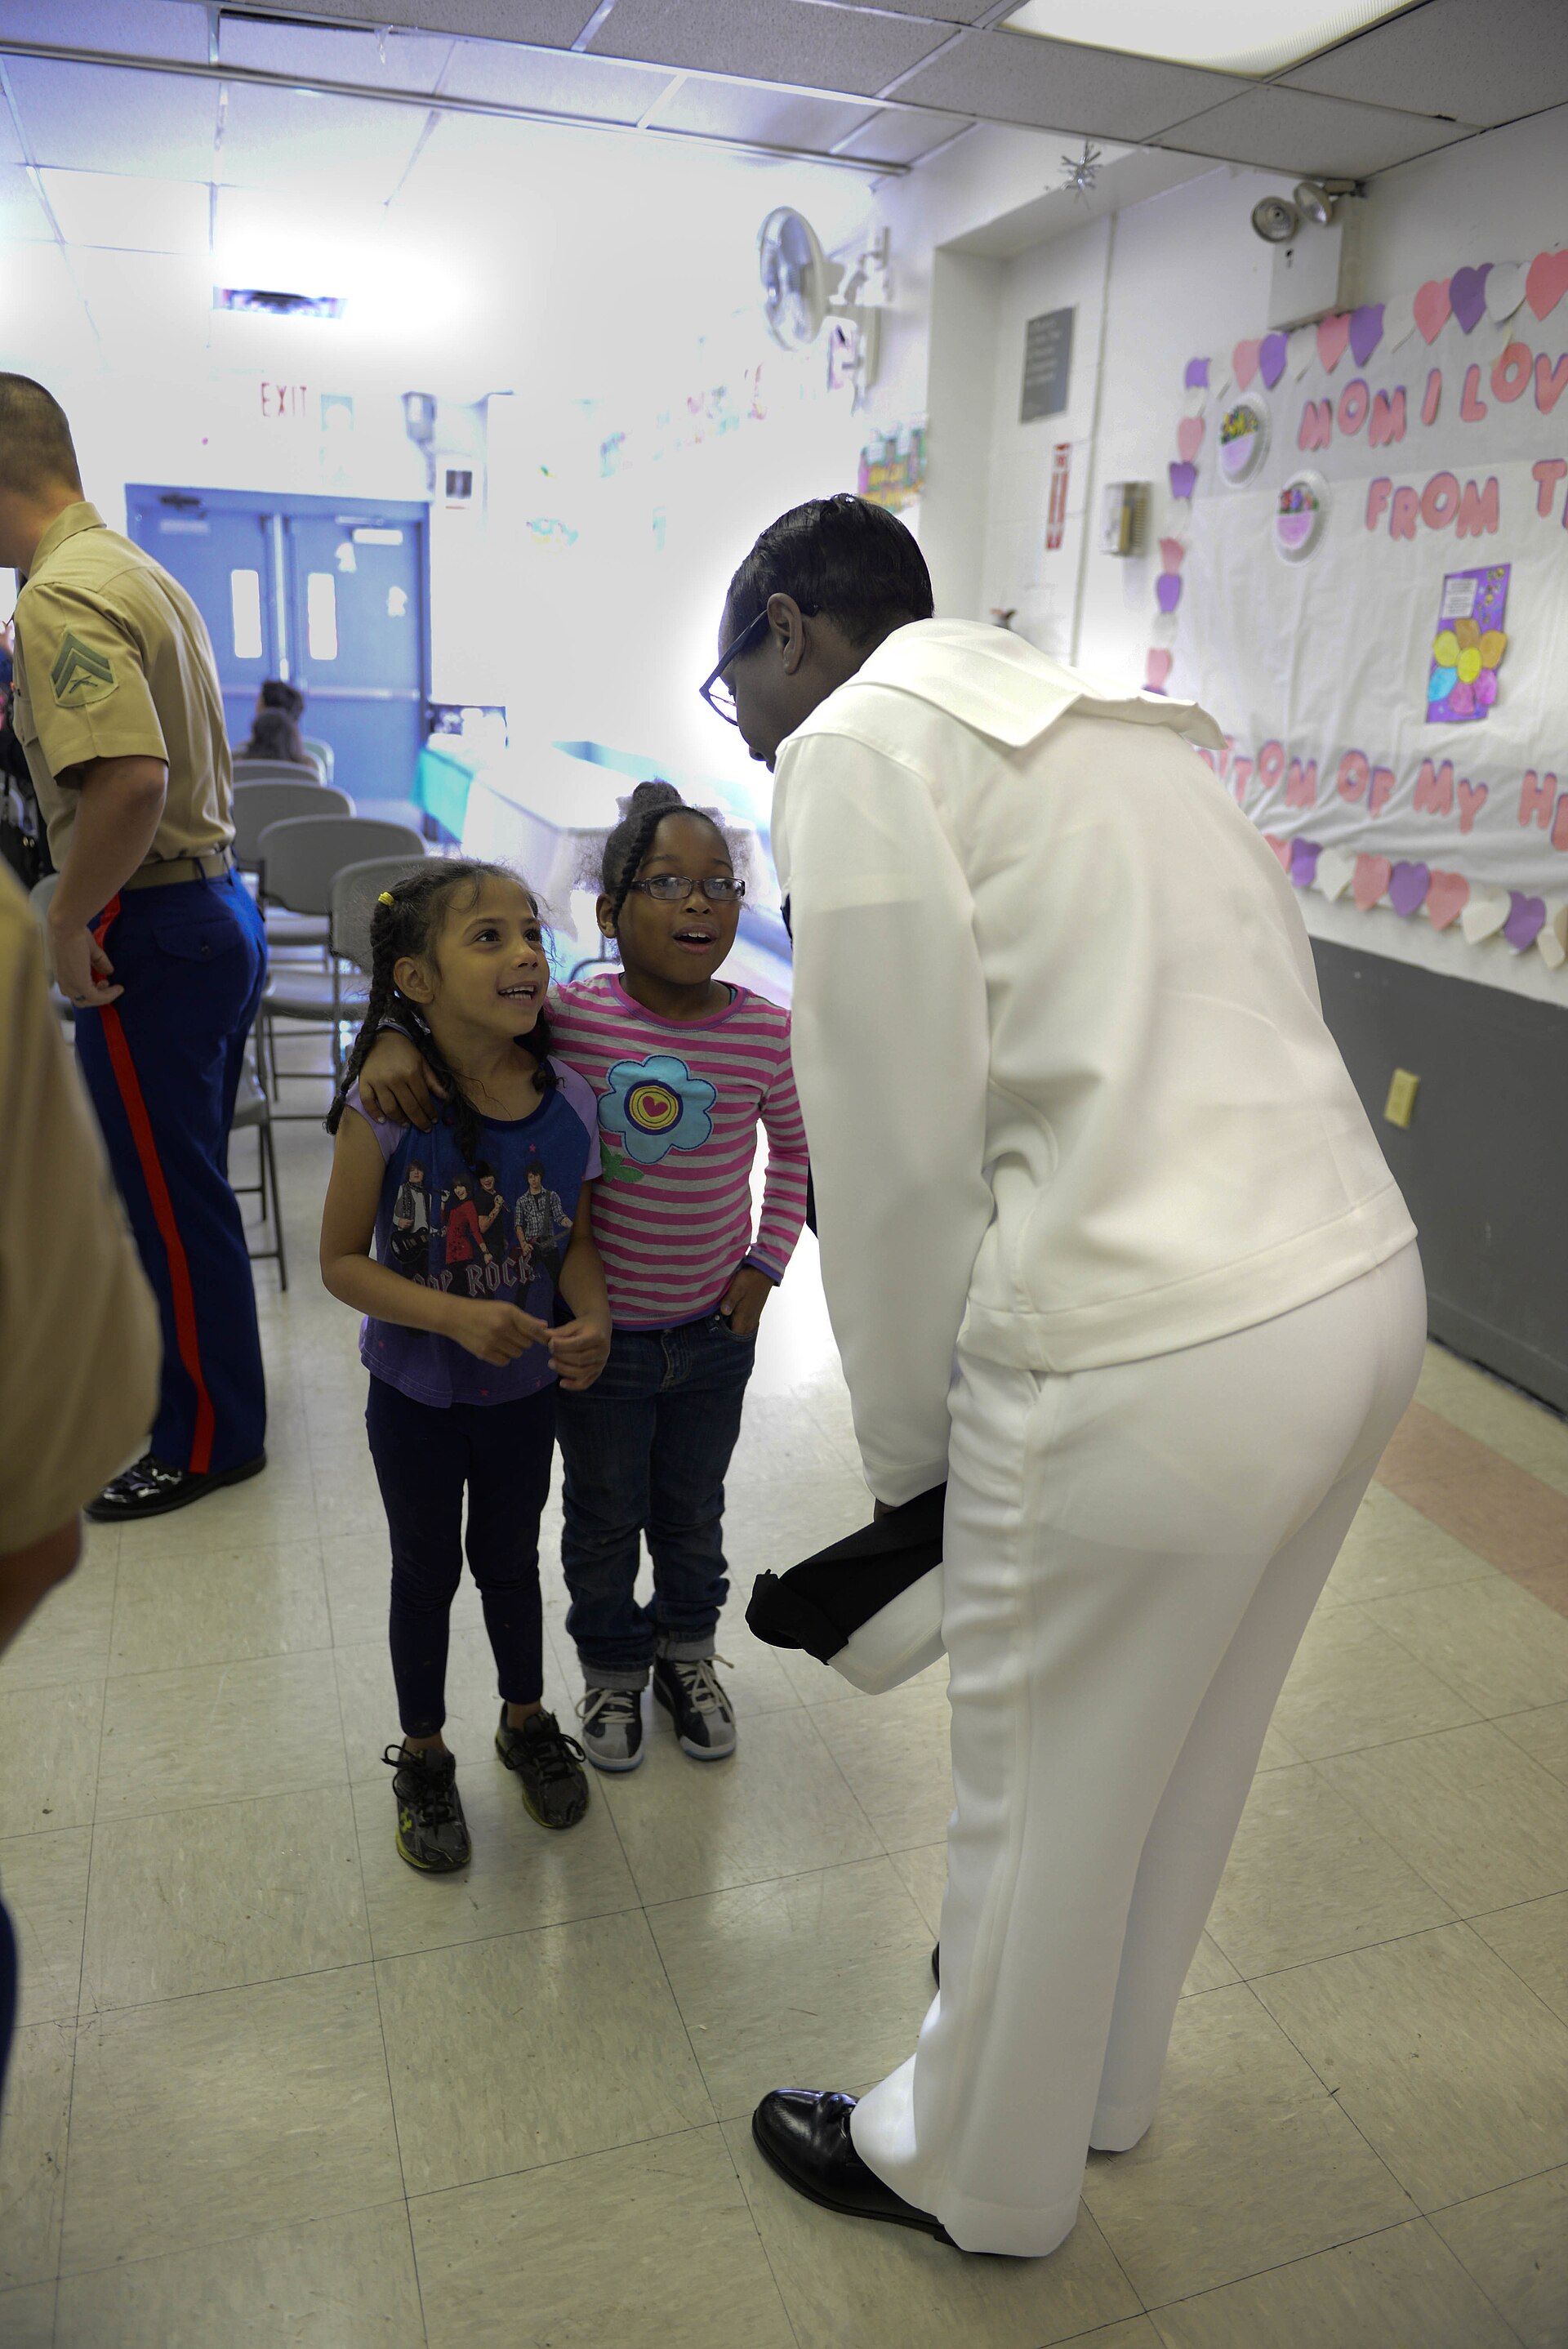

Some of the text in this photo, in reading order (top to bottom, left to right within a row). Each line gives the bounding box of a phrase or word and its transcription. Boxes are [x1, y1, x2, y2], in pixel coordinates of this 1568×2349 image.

[261, 381, 307, 417] EXIT
[1298, 377, 1406, 452] MOM
[1421, 368, 1443, 426] I
[1366, 471, 1499, 540] FROM
[1338, 750, 1395, 818] OF
[1414, 757, 1489, 834] MY
[466, 1255, 536, 1297] ROCK
